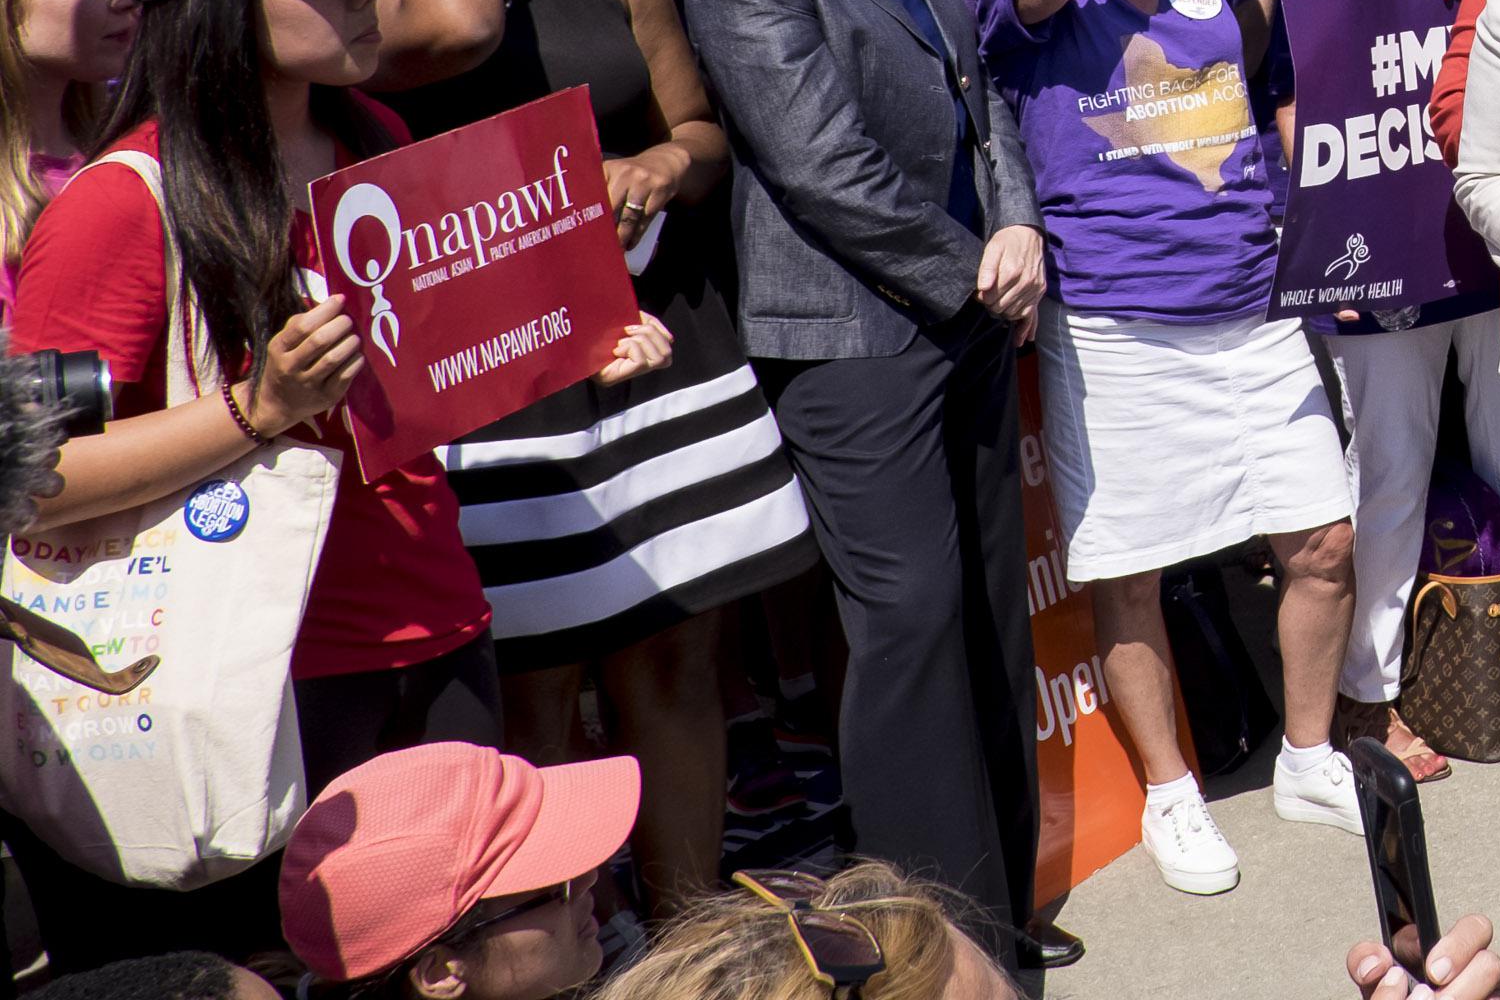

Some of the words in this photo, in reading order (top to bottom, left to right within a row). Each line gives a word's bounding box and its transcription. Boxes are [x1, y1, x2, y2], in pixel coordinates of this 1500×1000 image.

[1078, 84, 1155, 113] FIGHTING
[1159, 75, 1201, 96] BACK
[1207, 63, 1239, 85] FOR
[1125, 91, 1208, 123] ABORTION
[1163, 138, 1195, 154] WHOLE
[401, 144, 573, 270] napawf
[412, 266, 450, 293] NATIONAL
[451, 257, 474, 278] ASIAN
[489, 238, 517, 262] PACIFIC
[518, 225, 552, 251] AMERICAN
[551, 209, 583, 237] WOMEN'S
[582, 202, 605, 222] FORUM
[1280, 289, 1315, 308] WHOLE
[1317, 283, 1365, 305] WOMAN'S
[1367, 278, 1403, 300] HEALTH
[427, 306, 572, 393] WWW.NAPAWF.ORG
